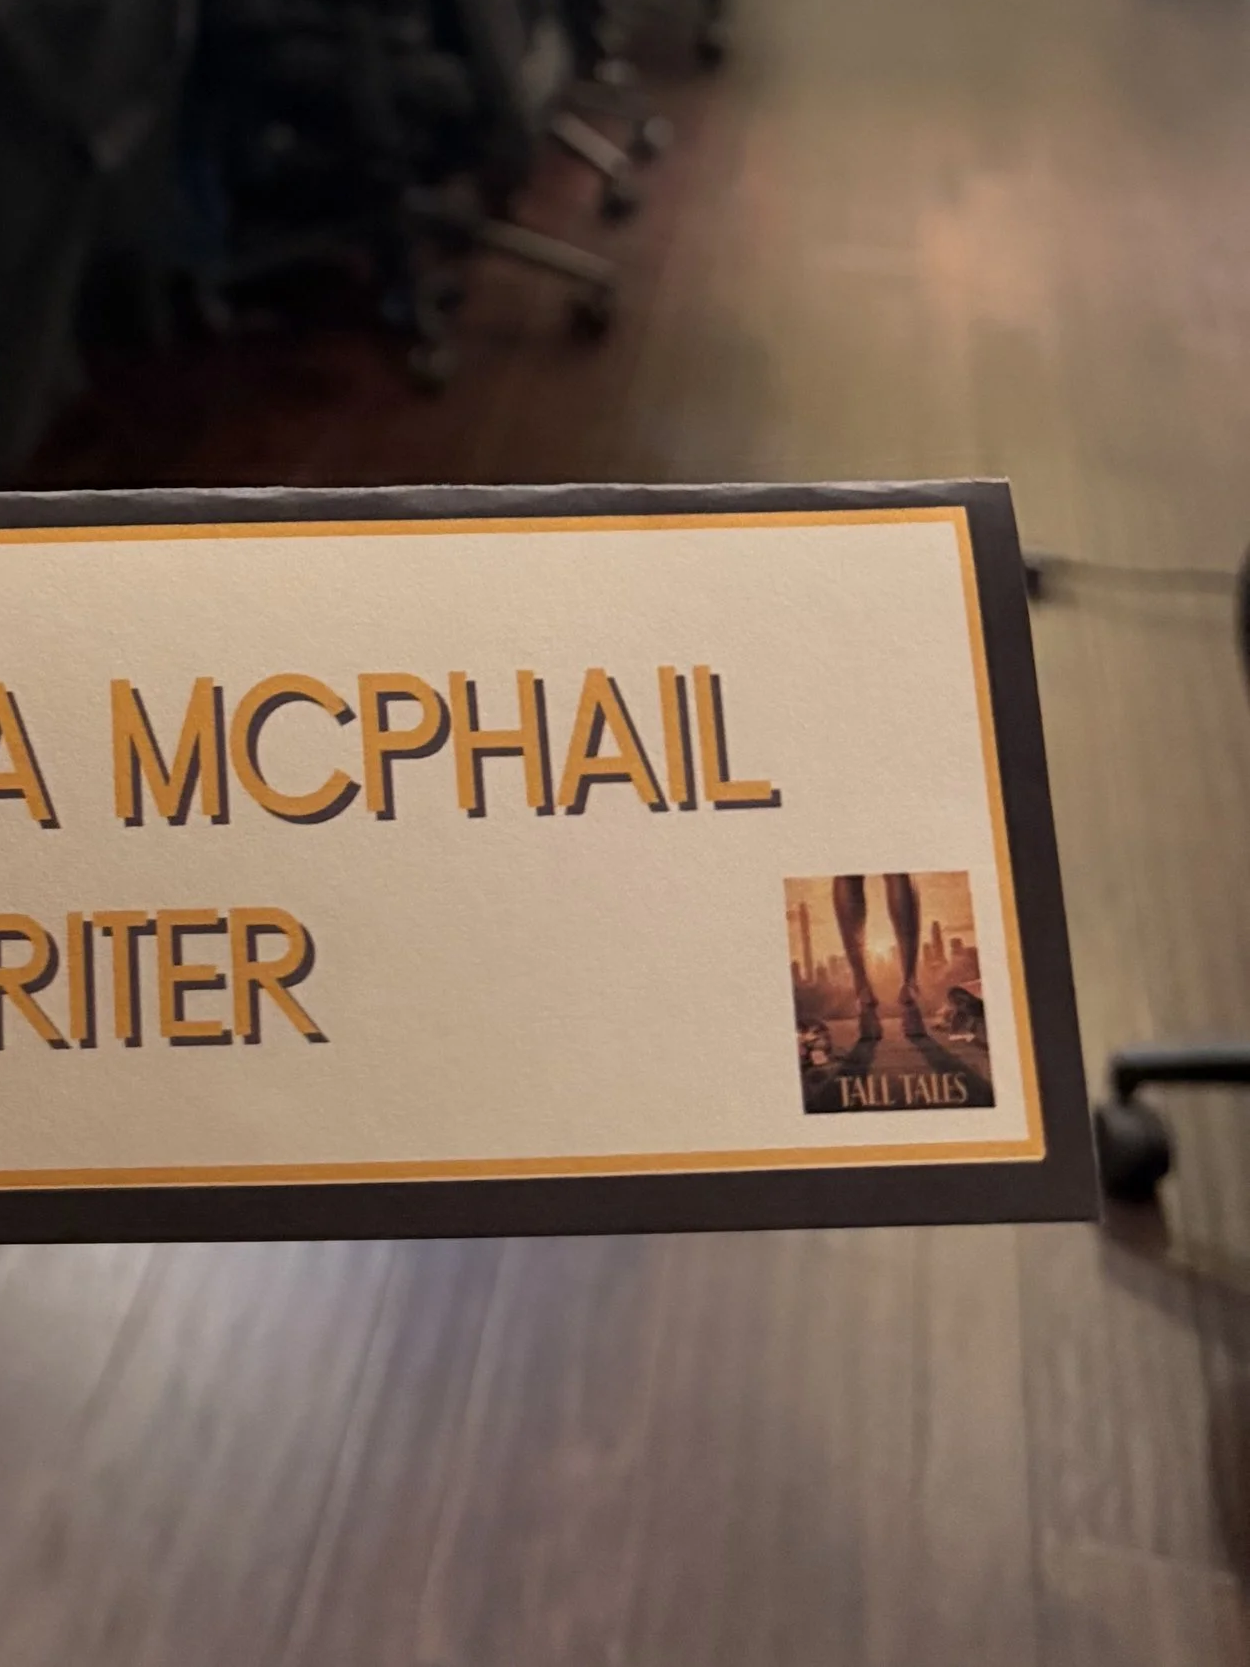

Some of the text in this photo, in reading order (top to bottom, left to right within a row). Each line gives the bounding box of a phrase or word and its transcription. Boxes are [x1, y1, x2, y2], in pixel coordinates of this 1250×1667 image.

[110, 664, 782, 826] MCPHAIL
[836, 1072, 969, 1107] TALL TALES
